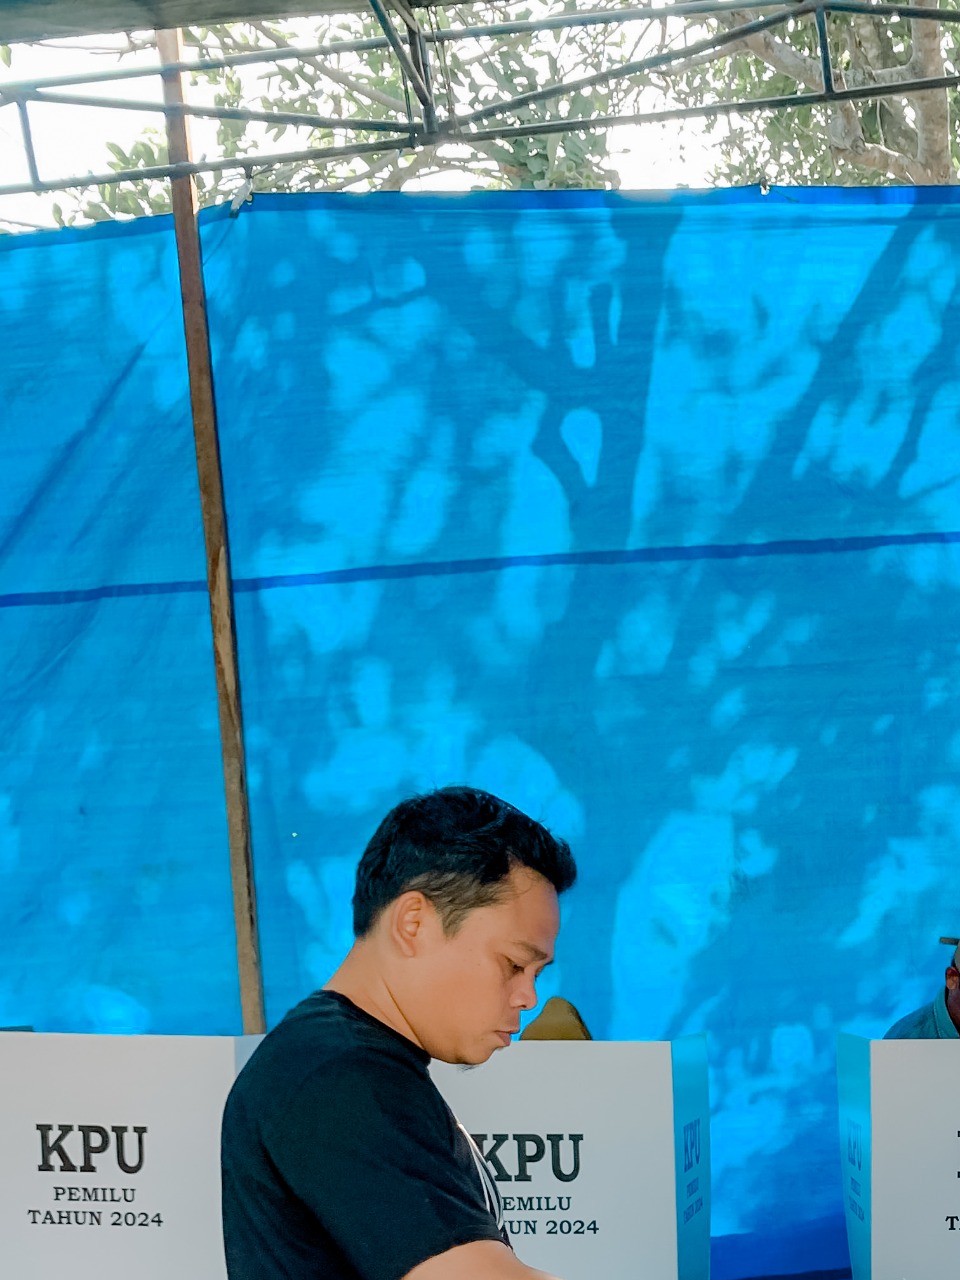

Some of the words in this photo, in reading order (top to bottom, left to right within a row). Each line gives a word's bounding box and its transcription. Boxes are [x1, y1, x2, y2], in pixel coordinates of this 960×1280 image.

[35, 1123, 148, 1174] KPU
[470, 1133, 584, 1183] KPU
[53, 1186, 137, 1203] PEMILU
[501, 1196, 572, 1211] EMILU
[27, 1209, 103, 1226] TAHUN
[111, 1211, 164, 1227] 2024
[545, 1220, 600, 1235] 2024
